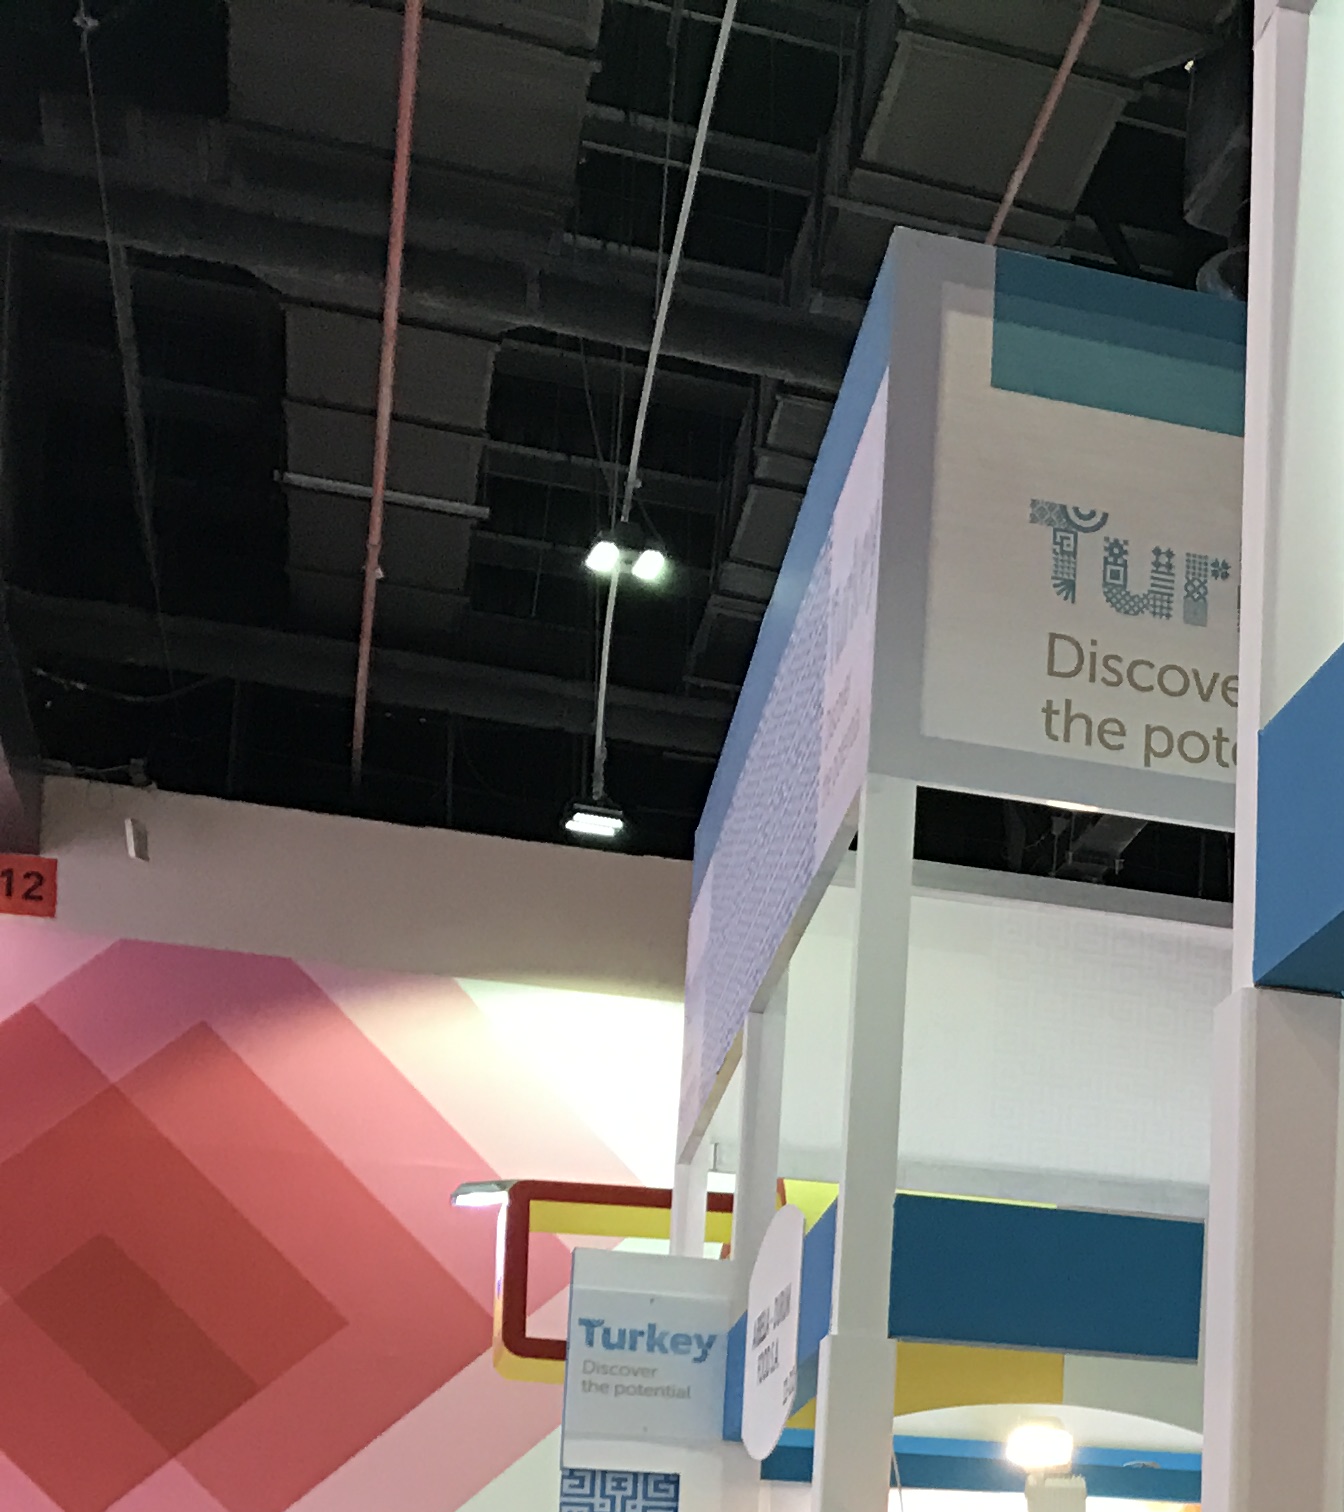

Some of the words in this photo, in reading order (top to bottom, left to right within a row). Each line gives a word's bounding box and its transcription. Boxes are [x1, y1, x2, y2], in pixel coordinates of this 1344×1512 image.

[1047, 631, 1239, 708] Discove
[1042, 699, 1127, 751] the
[578, 1317, 717, 1364] Turkey
[581, 1359, 658, 1378] Discover
[581, 1379, 610, 1397] the
[614, 1381, 691, 1400] potential
